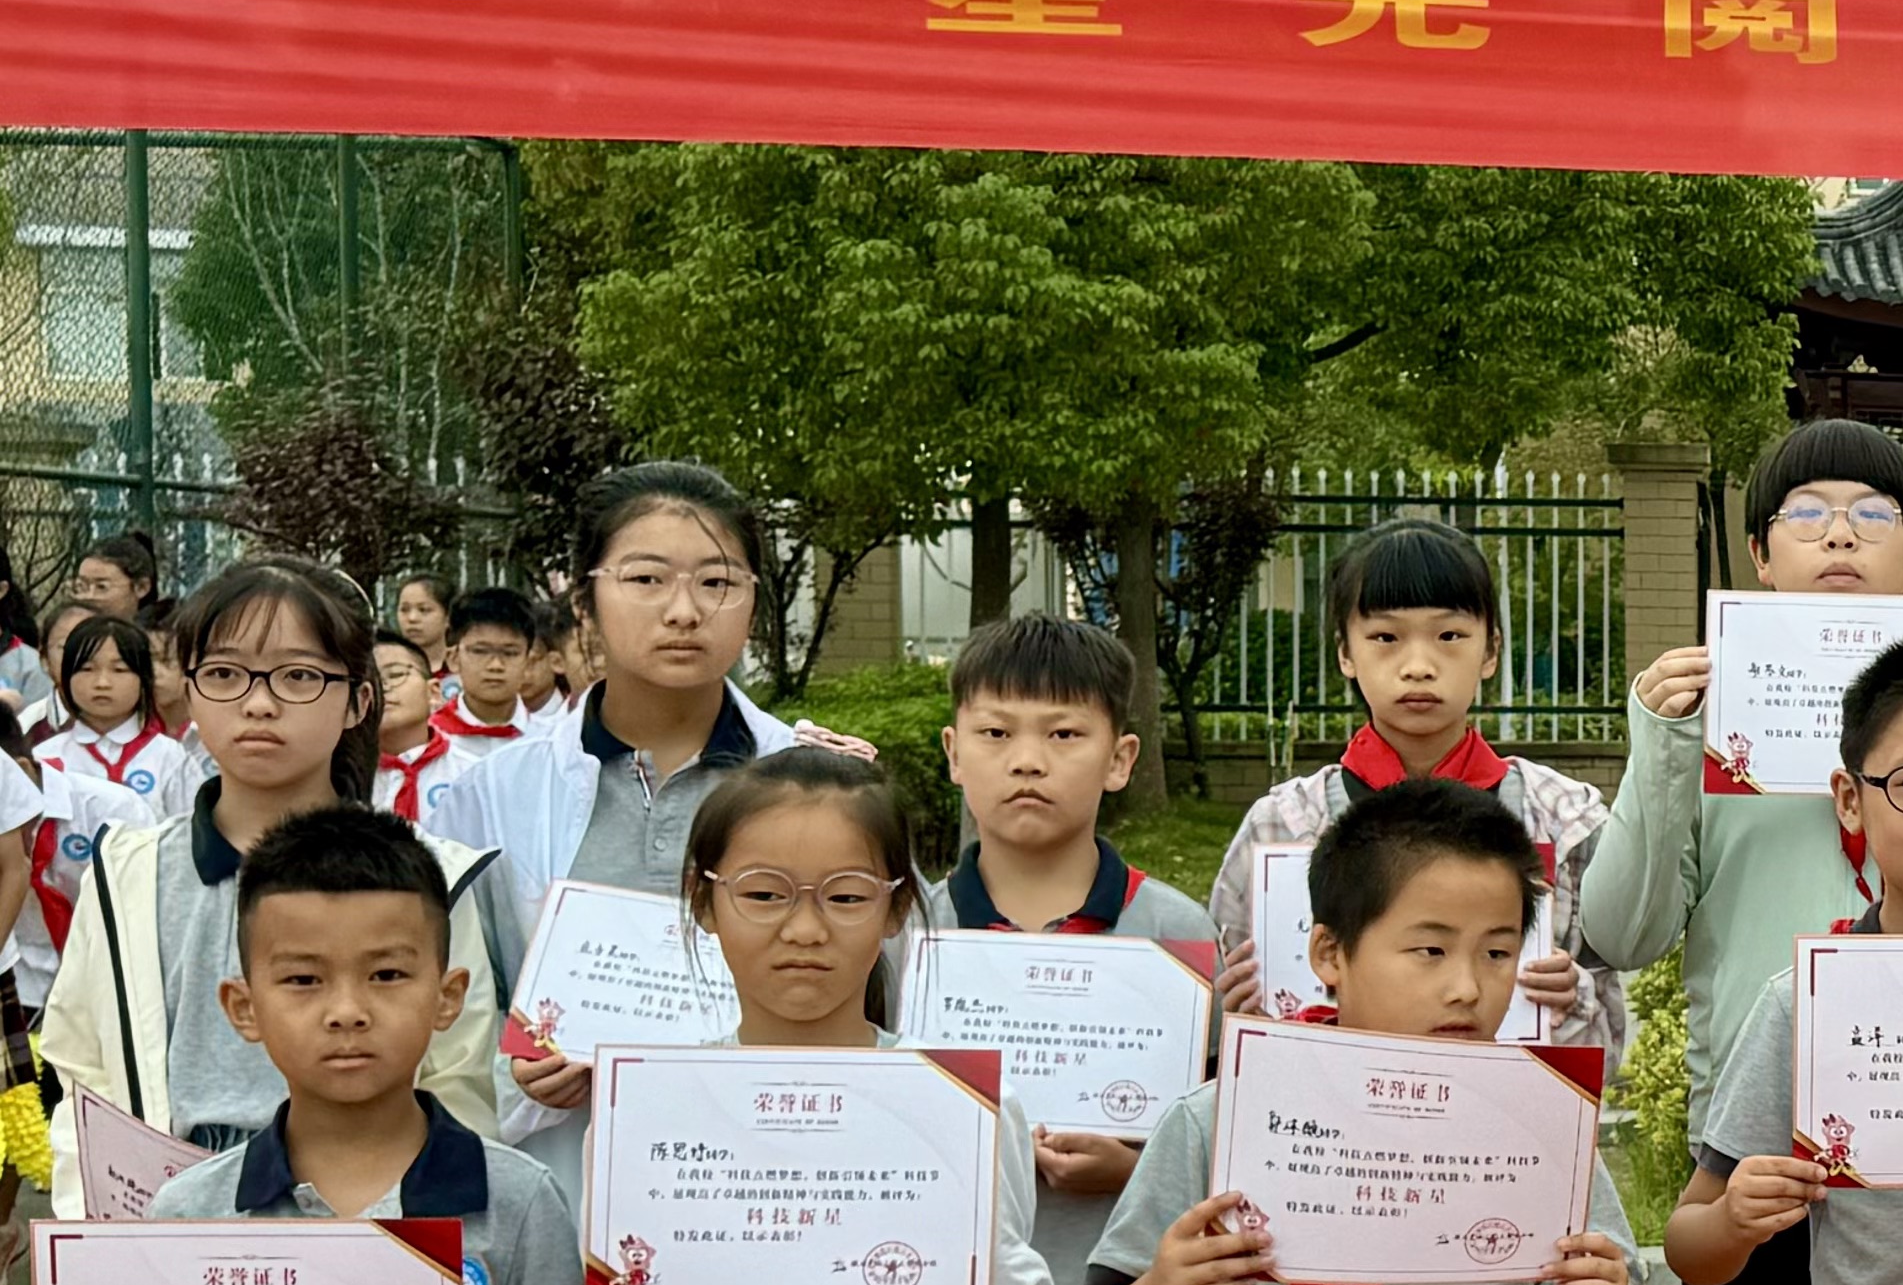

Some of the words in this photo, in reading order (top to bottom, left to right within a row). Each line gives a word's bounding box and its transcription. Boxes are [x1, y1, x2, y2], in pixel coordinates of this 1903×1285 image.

[753, 1093, 843, 1112] 荣誉证书
[747, 1207, 842, 1226] 科技新星
